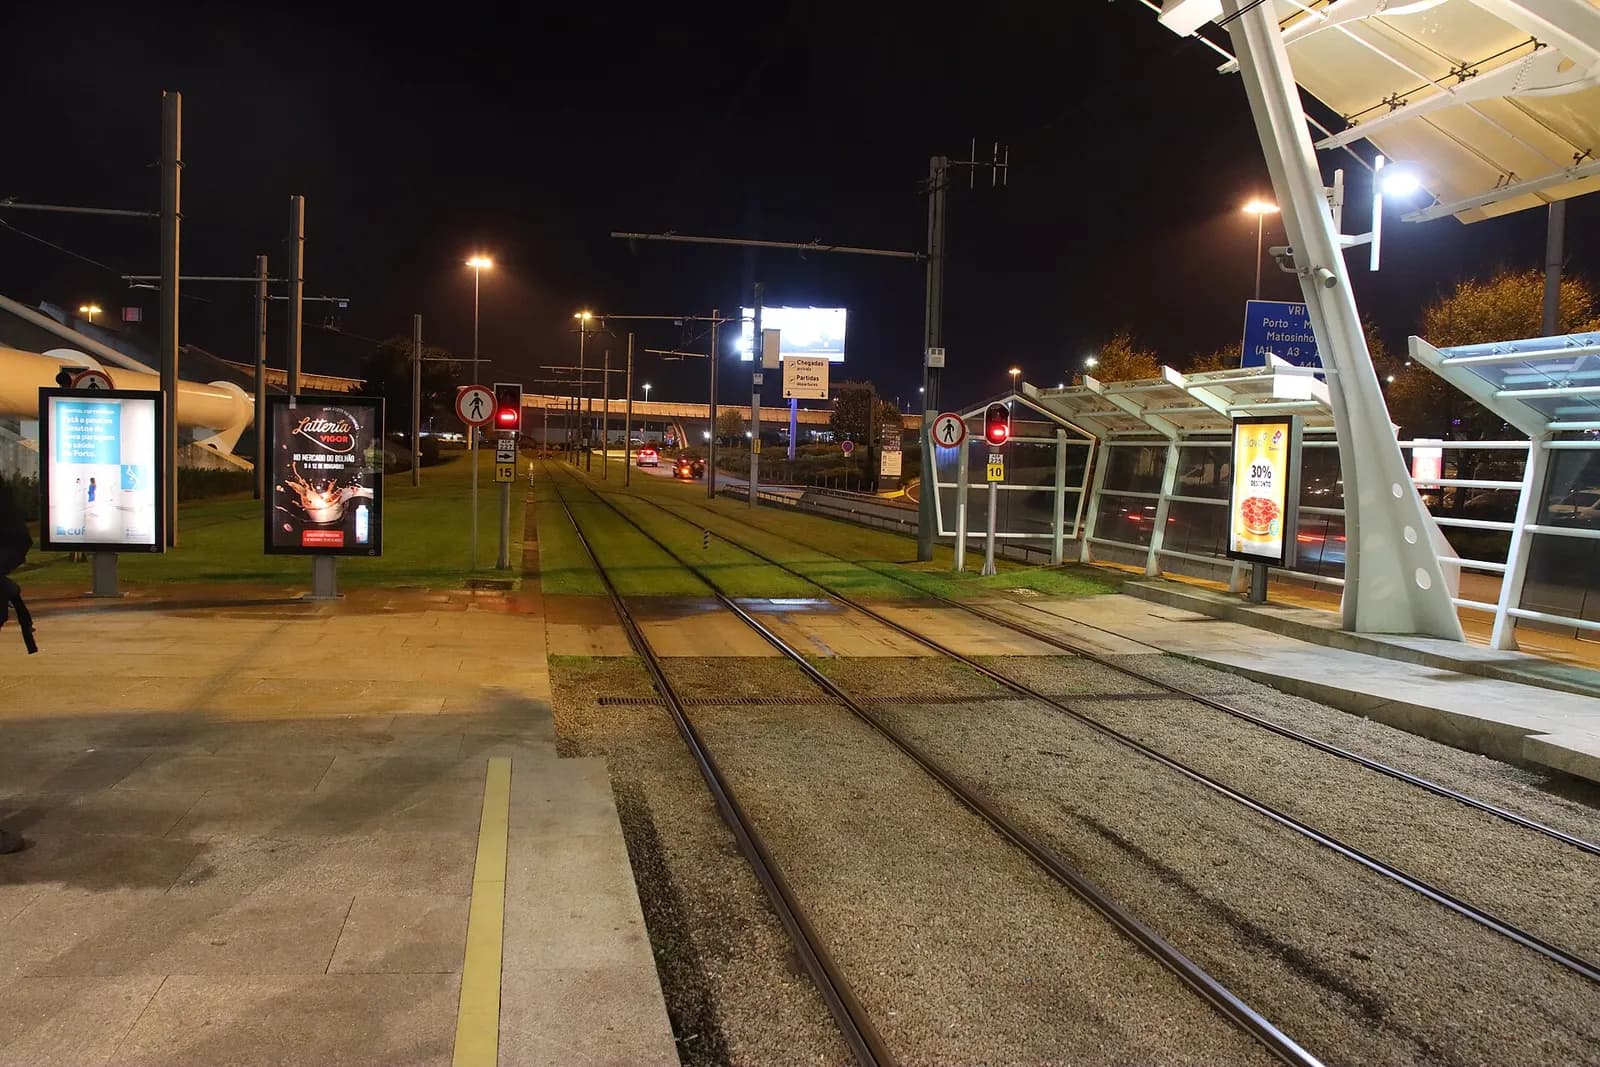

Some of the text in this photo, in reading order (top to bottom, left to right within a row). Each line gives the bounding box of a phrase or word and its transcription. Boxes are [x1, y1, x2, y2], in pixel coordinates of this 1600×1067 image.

[1288, 305, 1304, 315] VRI
[1263, 317, 1289, 328] Porto
[1266, 331, 1315, 343] Matosinho
[1287, 347, 1300, 357] A3
[796, 359, 824, 367] Chegadas
[796, 374, 819, 382] Partidas
[291, 416, 351, 435] Latteria
[320, 435, 348, 443] VIGOR
[302, 454, 326, 462] MERCADO
[499, 468, 512, 478] 15
[990, 467, 1001, 477] 10
[1251, 465, 1272, 479] 30%
